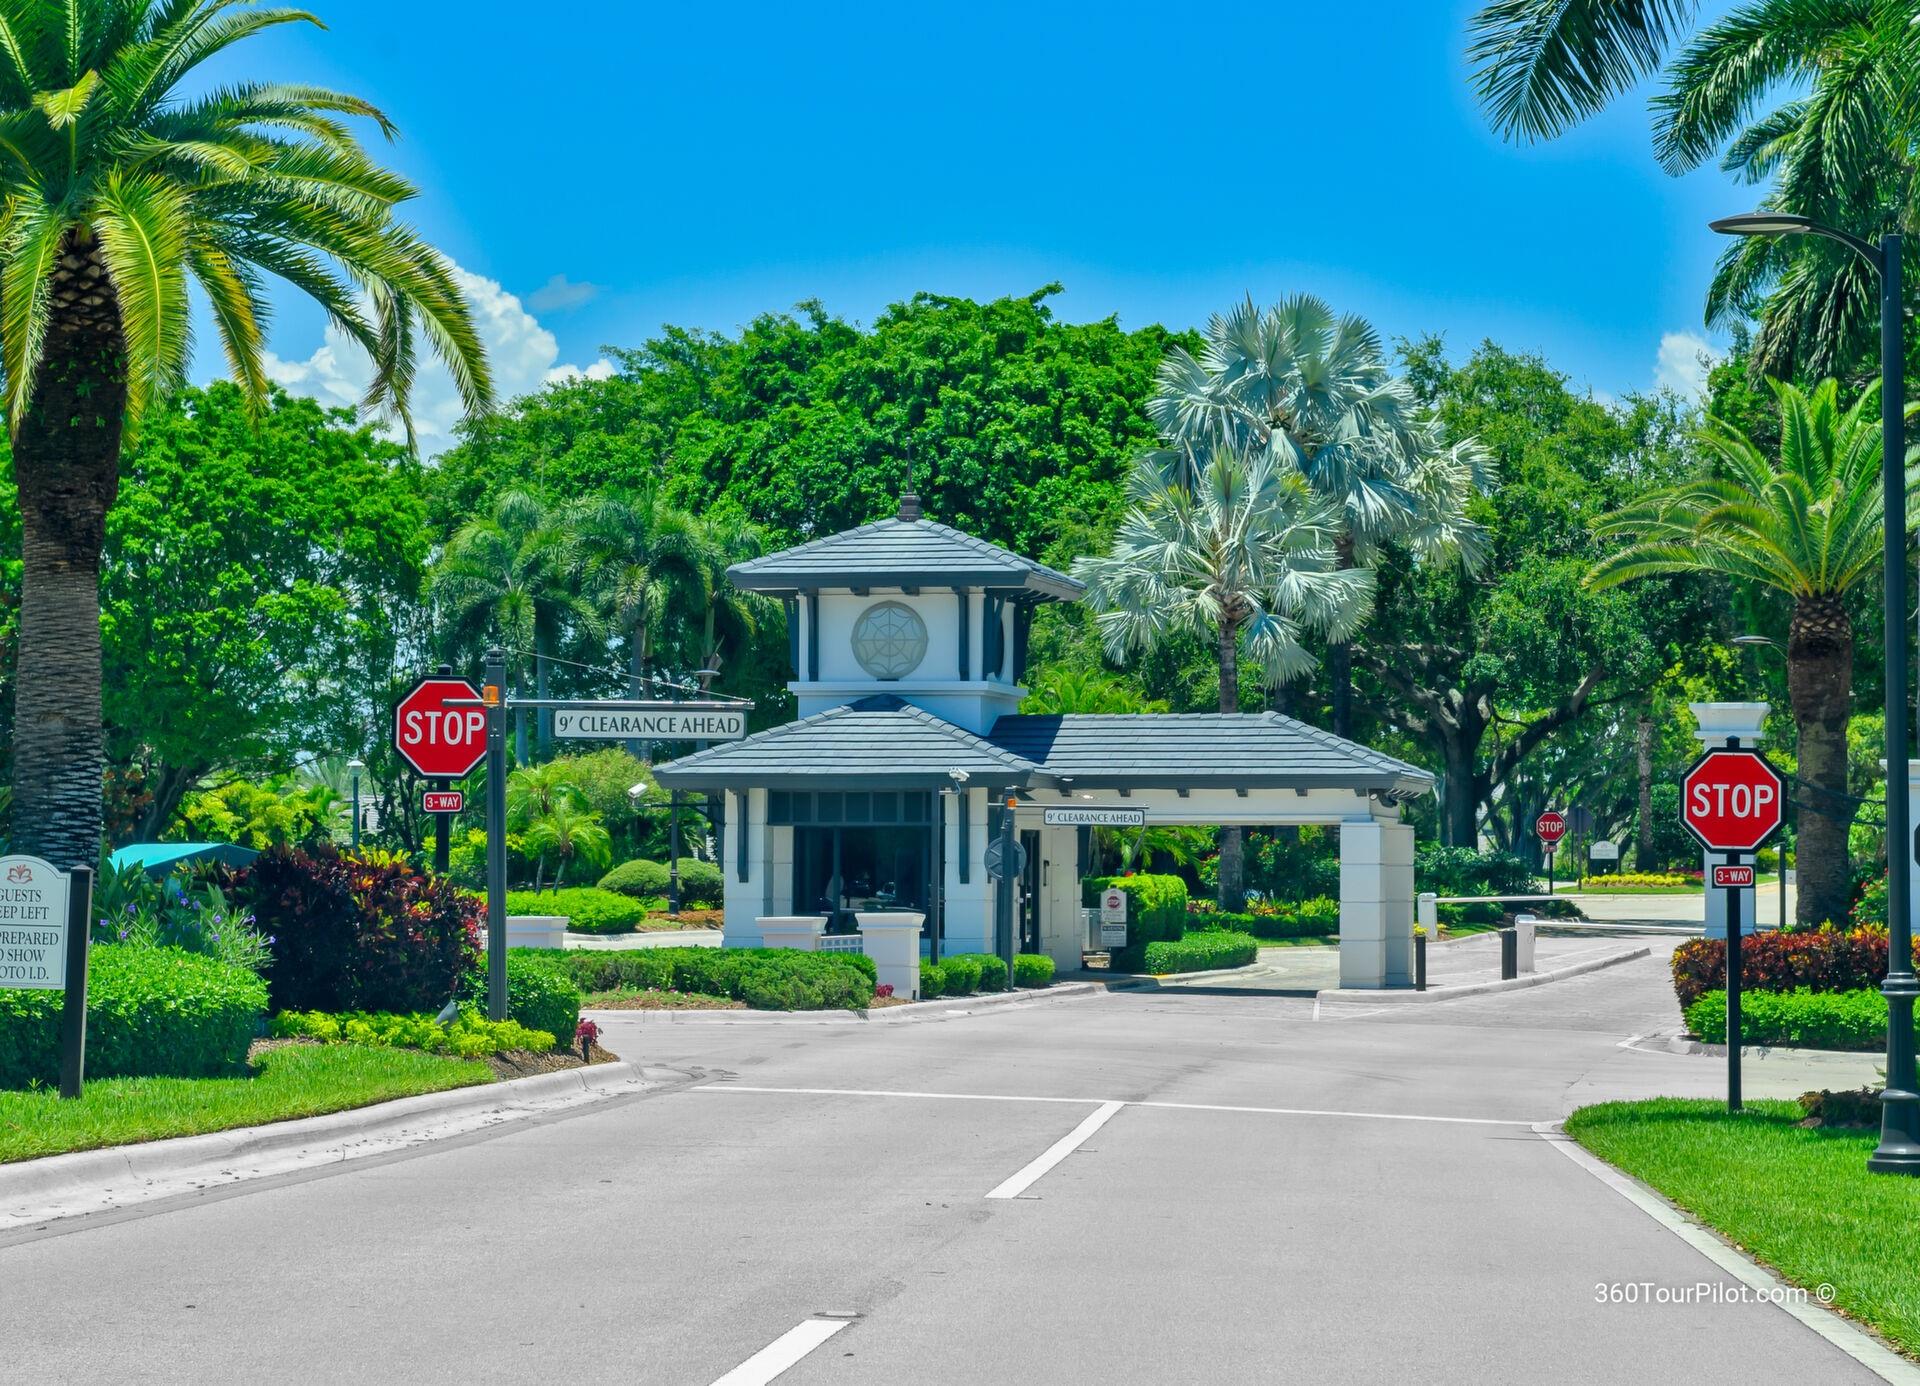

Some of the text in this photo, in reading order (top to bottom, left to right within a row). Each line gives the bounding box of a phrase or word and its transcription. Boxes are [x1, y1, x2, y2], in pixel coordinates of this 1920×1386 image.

[404, 710, 485, 745] STOP
[559, 715, 740, 734] 9' CLEARANCE AHEAD
[427, 797, 460, 808] 3-WAY
[1691, 783, 1774, 818] STOP
[1057, 812, 1108, 823] CLEARANCE
[1109, 813, 1141, 823] AHEAD
[1539, 821, 1563, 833] STOP
[1717, 870, 1750, 882] 3-WAY
[20, 906, 50, 920] LEFT
[0, 930, 59, 946] REPARED
[7, 948, 46, 962] SHOW
[29, 966, 49, 980] I.D.
